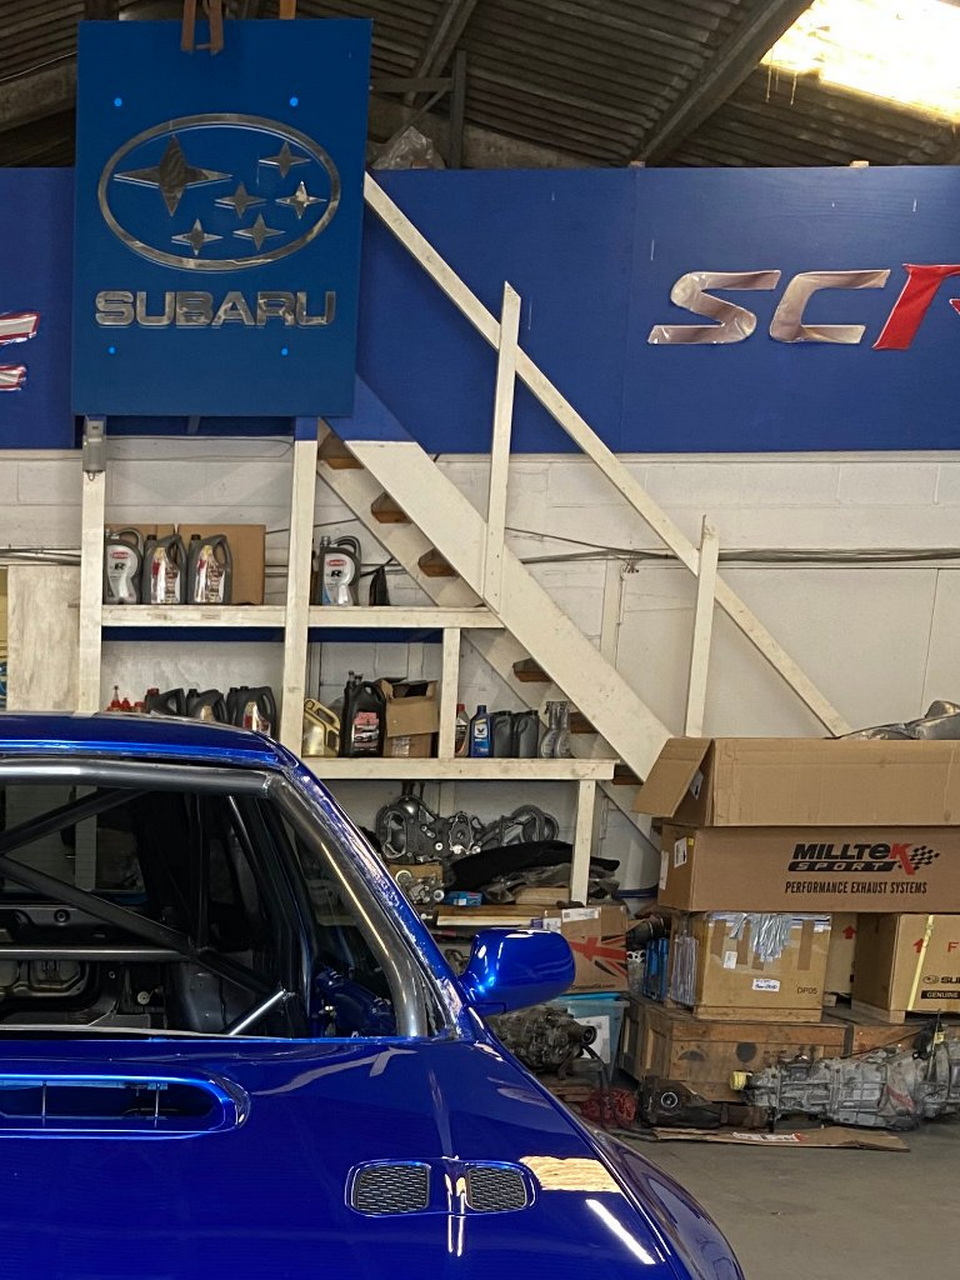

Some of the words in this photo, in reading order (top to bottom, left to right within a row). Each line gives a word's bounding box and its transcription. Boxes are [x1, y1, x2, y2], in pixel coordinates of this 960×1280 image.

[95, 290, 336, 328] SUBARU
[796, 862, 884, 870] SPORT
[785, 881, 848, 894] PERFORMANCE
[851, 881, 889, 893] EXHAUST
[890, 882, 928, 894] SYSTEMS
